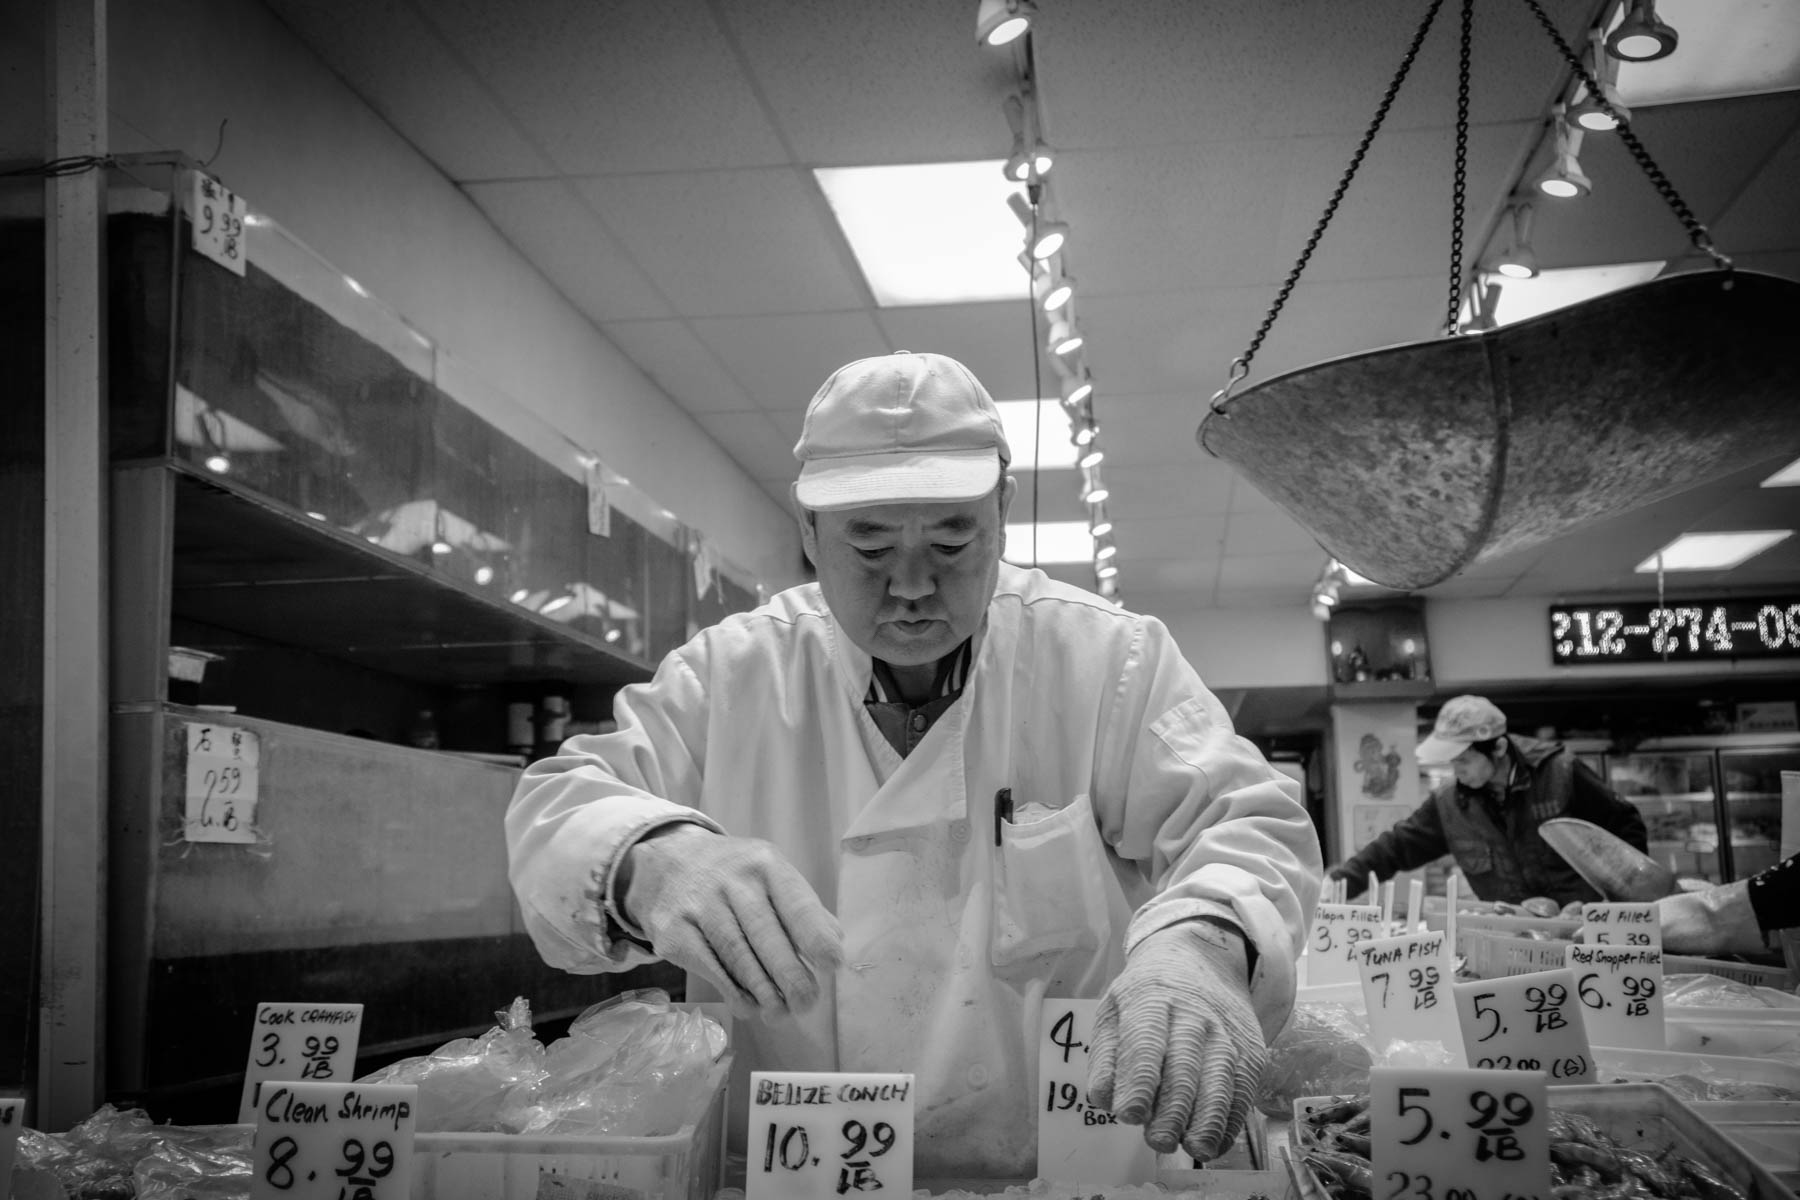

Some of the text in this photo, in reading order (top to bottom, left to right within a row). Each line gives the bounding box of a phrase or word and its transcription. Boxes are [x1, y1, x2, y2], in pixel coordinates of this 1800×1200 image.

[1351, 910, 1381, 923] Fillet
[1586, 909, 1653, 923] Cod Fillet
[1362, 938, 1442, 967] TUNA FISH
[1572, 946, 1594, 966] Red
[1596, 949, 1637, 974] Snapper
[1414, 990, 1438, 1010] LB
[1626, 1002, 1650, 1016] LB
[258, 1007, 295, 1026] Cook
[1535, 1011, 1568, 1033] LB
[301, 1060, 334, 1080] LB
[755, 1078, 909, 1106] BELIZE CONCH
[265, 1088, 328, 1123] Clean
[337, 1091, 410, 1131] Shrimp
[1084, 1110, 1119, 1126] Box
[1475, 1135, 1526, 1162] LB
[836, 1167, 884, 1195] LB
